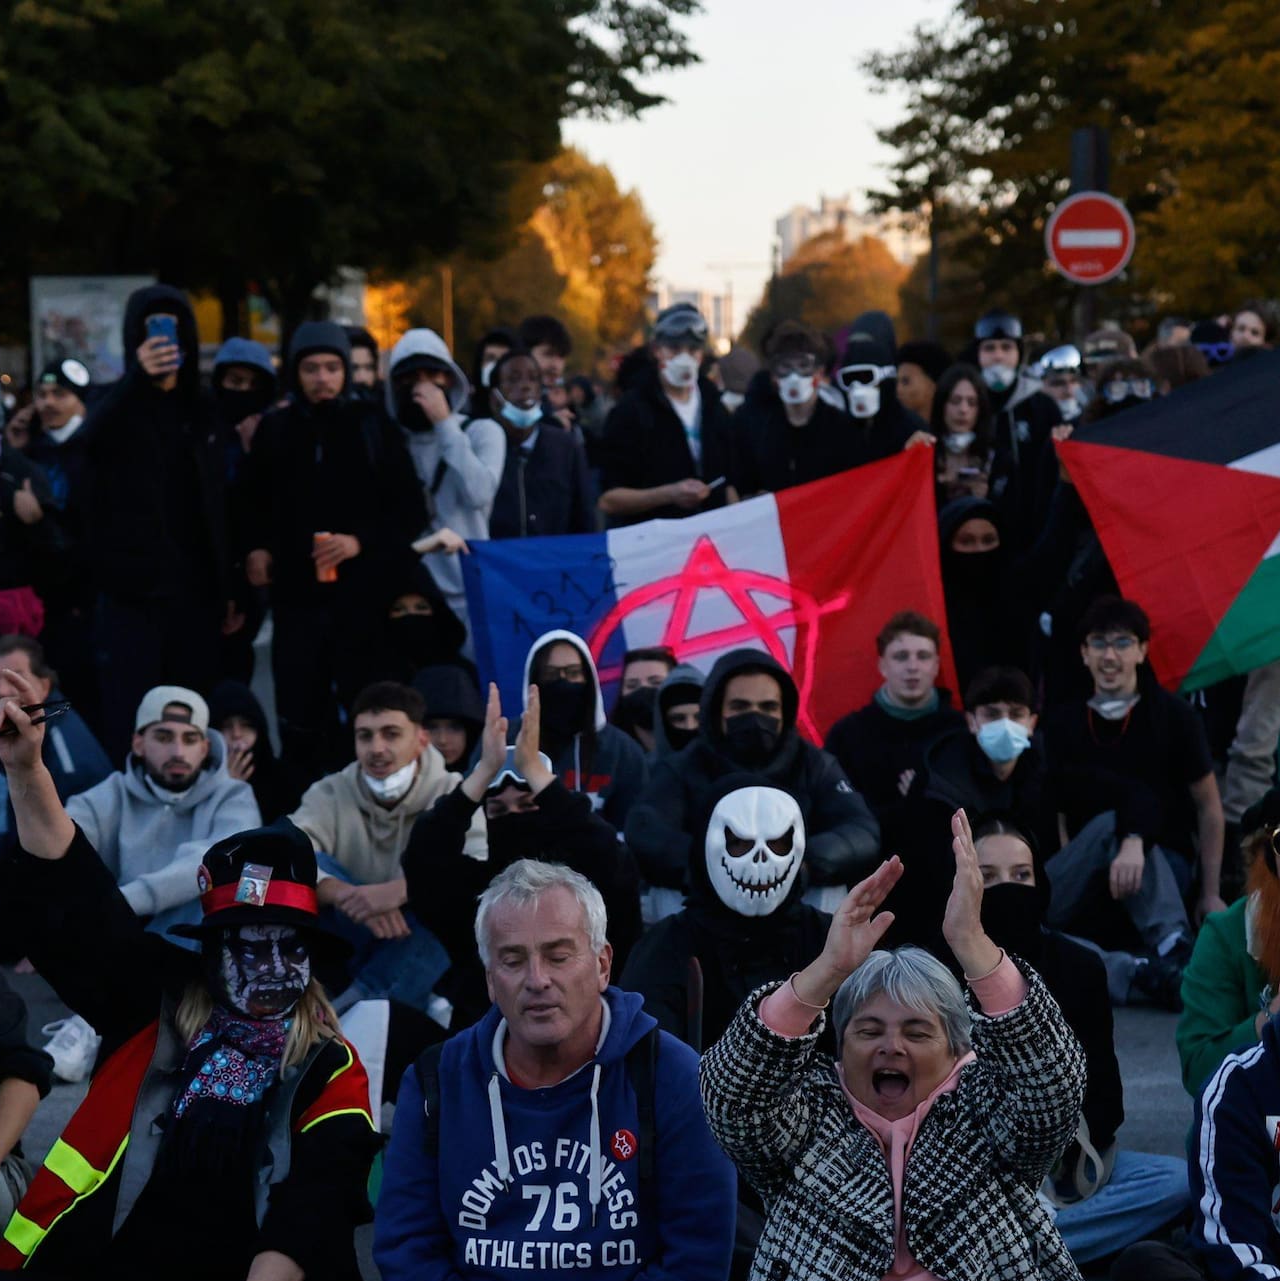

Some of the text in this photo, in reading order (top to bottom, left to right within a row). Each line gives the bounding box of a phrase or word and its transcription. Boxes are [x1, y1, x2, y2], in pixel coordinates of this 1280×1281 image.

[521, 1181, 581, 1232] 76
[464, 1237, 641, 1270] ATHLETICS CO.
